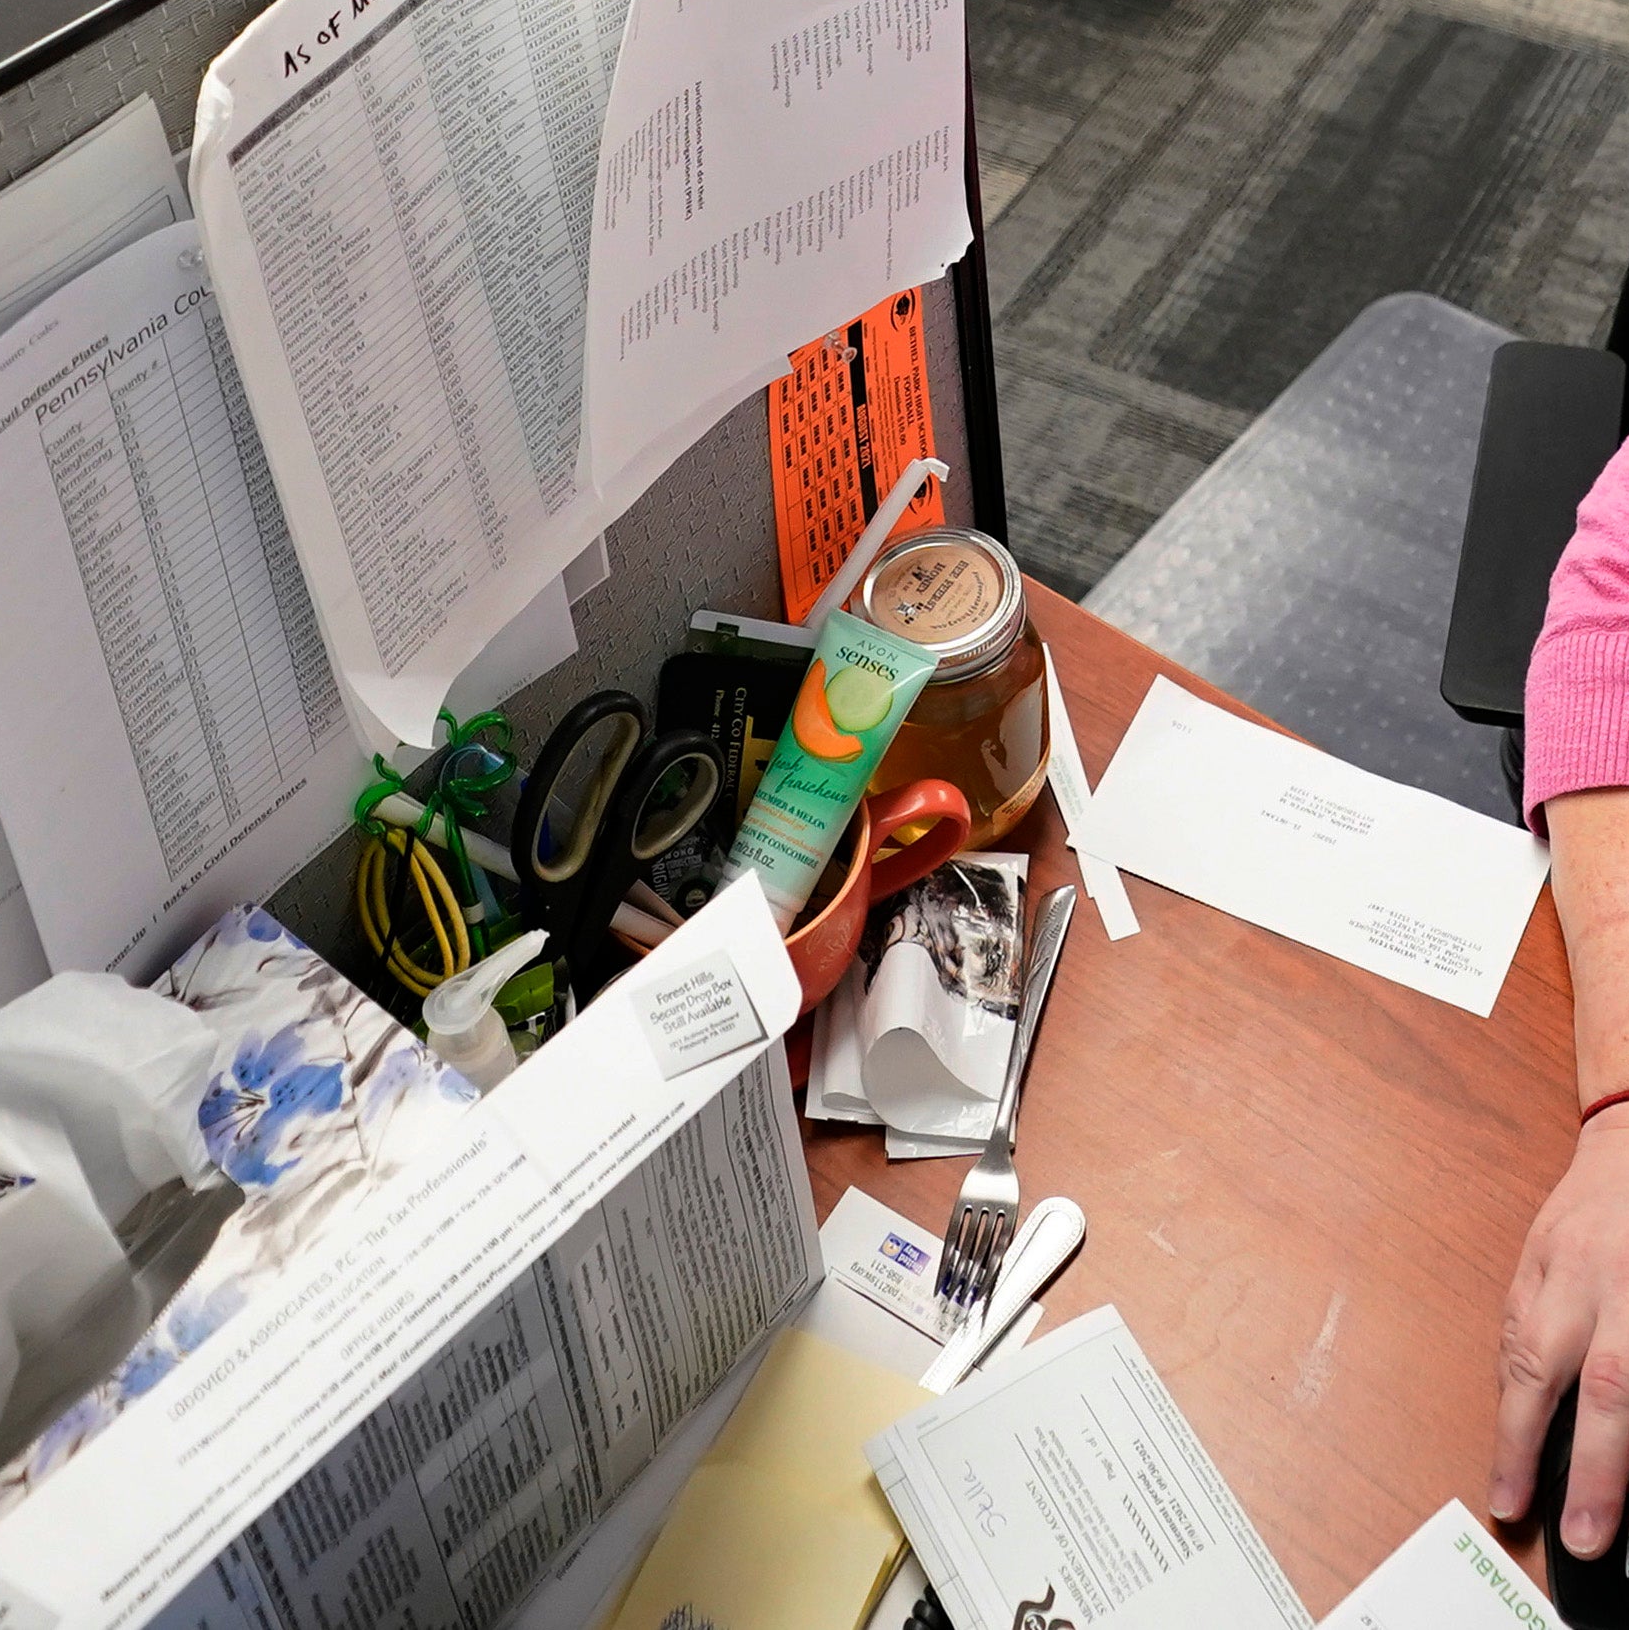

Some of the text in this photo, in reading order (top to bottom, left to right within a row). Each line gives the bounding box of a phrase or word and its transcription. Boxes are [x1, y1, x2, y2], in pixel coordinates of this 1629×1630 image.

[282, 43, 311, 79] AS
[316, 10, 343, 46] OF
[694, 81, 703, 144] Jurisdictions
[682, 114, 692, 184] investigations
[696, 170, 703, 183] do
[696, 185, 704, 209] their
[35, 308, 166, 427] Pennsylvania
[908, 326, 919, 365] BETHEL
[22, 362, 70, 411] Defense
[72, 332, 108, 368] Plates
[911, 366, 921, 392] PARK
[46, 365, 147, 458] County County
[893, 376, 906, 445] Donation $10.00
[902, 375, 914, 427] FOOTBALL
[914, 394, 924, 421] HIGH
[49, 433, 84, 470] Adams
[855, 404, 871, 469] AUGUST 2021
[54, 434, 104, 485] Allegheny
[58, 446, 112, 499] Armstrong
[914, 560, 945, 595] HONEY
[835, 644, 899, 682] senses
[856, 638, 898, 661] AVON
[733, 686, 746, 715] CITY
[725, 741, 740, 788] FEDERAL
[755, 831, 767, 843] ET
[788, 804, 828, 830] & MELON
[162, 776, 306, 912] Back to Civil Defense Plates
[1347, 918, 1483, 977] ALLEGHENY COUNTY TREASURER
[1371, 919, 1469, 963] ROOM COURTHOUSE
[1386, 916, 1448, 946] GRANT STREET
[1412, 919, 1482, 951] PITTSBURGH PA
[1367, 935, 1458, 976] JOHN K WEINSTEIN
[648, 975, 733, 1025] Secure Drop Box
[655, 968, 715, 1006] Forest Hills
[661, 992, 732, 1035] Still Available
[895, 1252, 923, 1275] United
[901, 1241, 921, 1260] Way
[333, 1255, 388, 1304] LOCATION
[337, 1288, 417, 1361] OFFICE HOURS
[231, 1345, 250, 1364] &
[1085, 1436, 1118, 1481] Page of
[1131, 1437, 1205, 1552] 07/01/2021 09/30/2021
[1135, 1467, 1194, 1558] Statement period:
[1024, 1478, 1109, 1615] STATEMENT OF ACCOUNT
